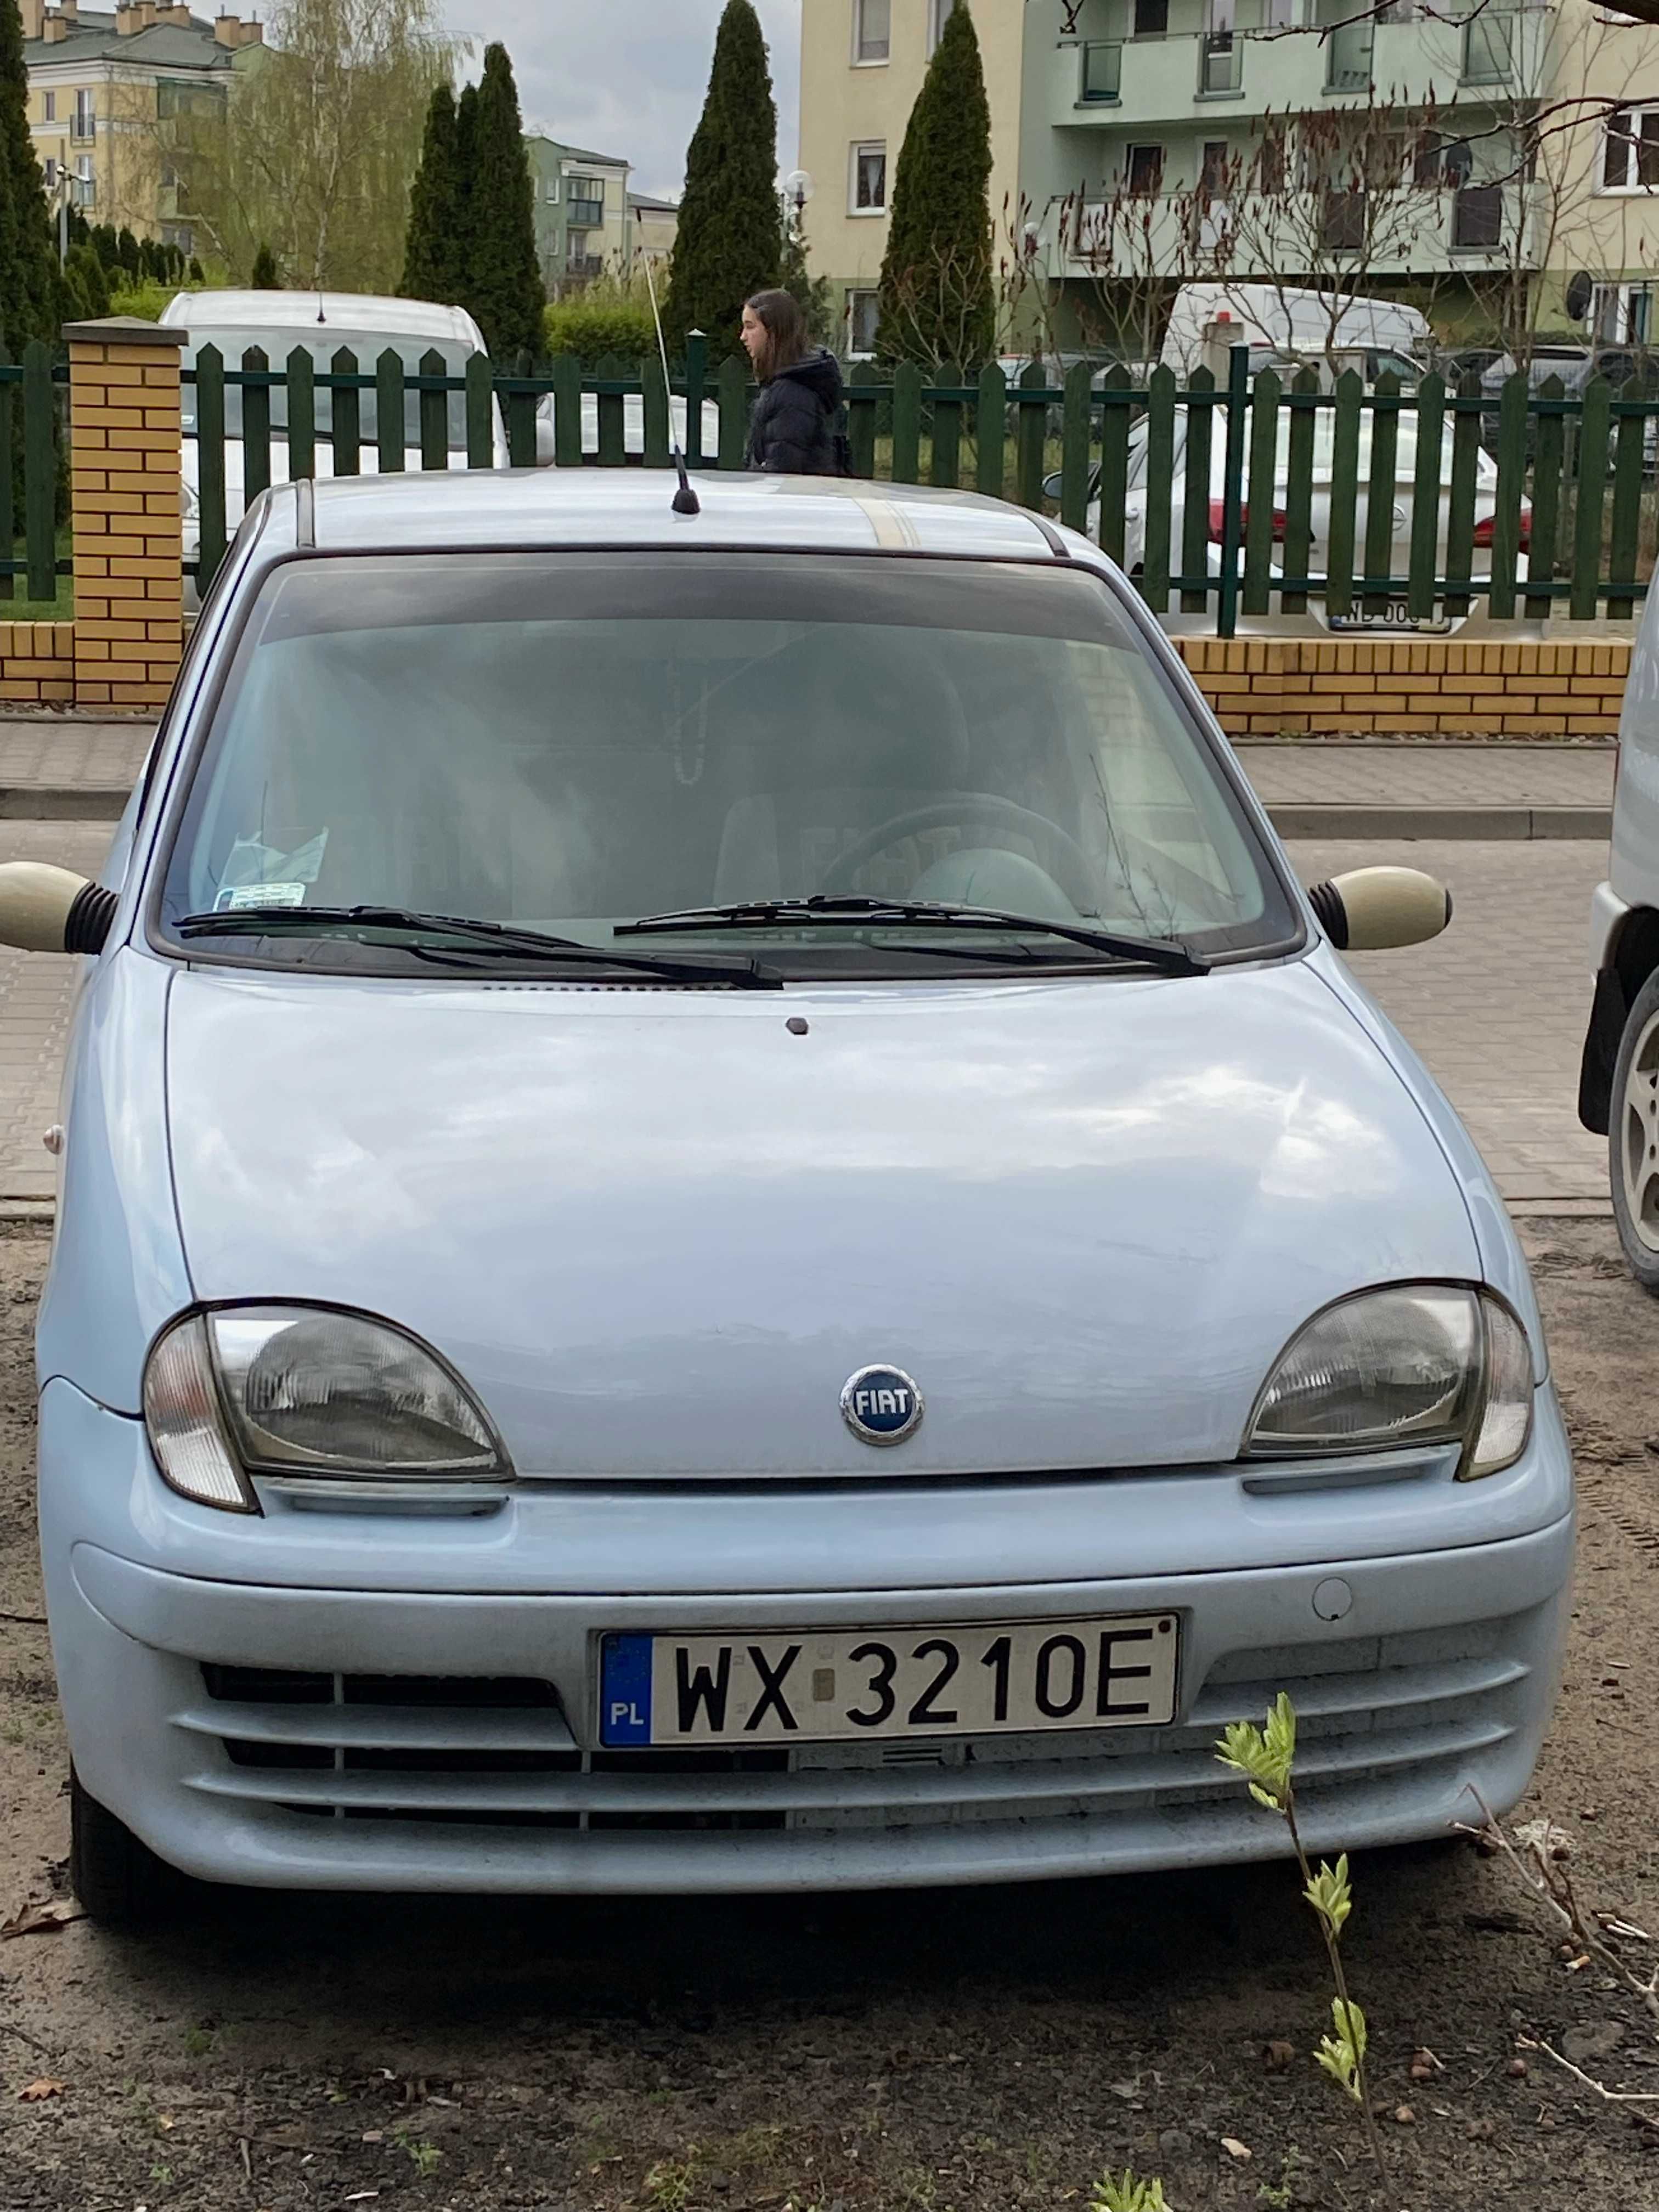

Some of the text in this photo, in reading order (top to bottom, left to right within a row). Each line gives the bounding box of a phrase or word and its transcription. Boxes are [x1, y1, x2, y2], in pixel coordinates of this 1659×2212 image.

[855, 1388, 909, 1415] FIAT
[675, 1628, 1154, 1733] WX 3210E
[611, 1702, 644, 1725] PL
